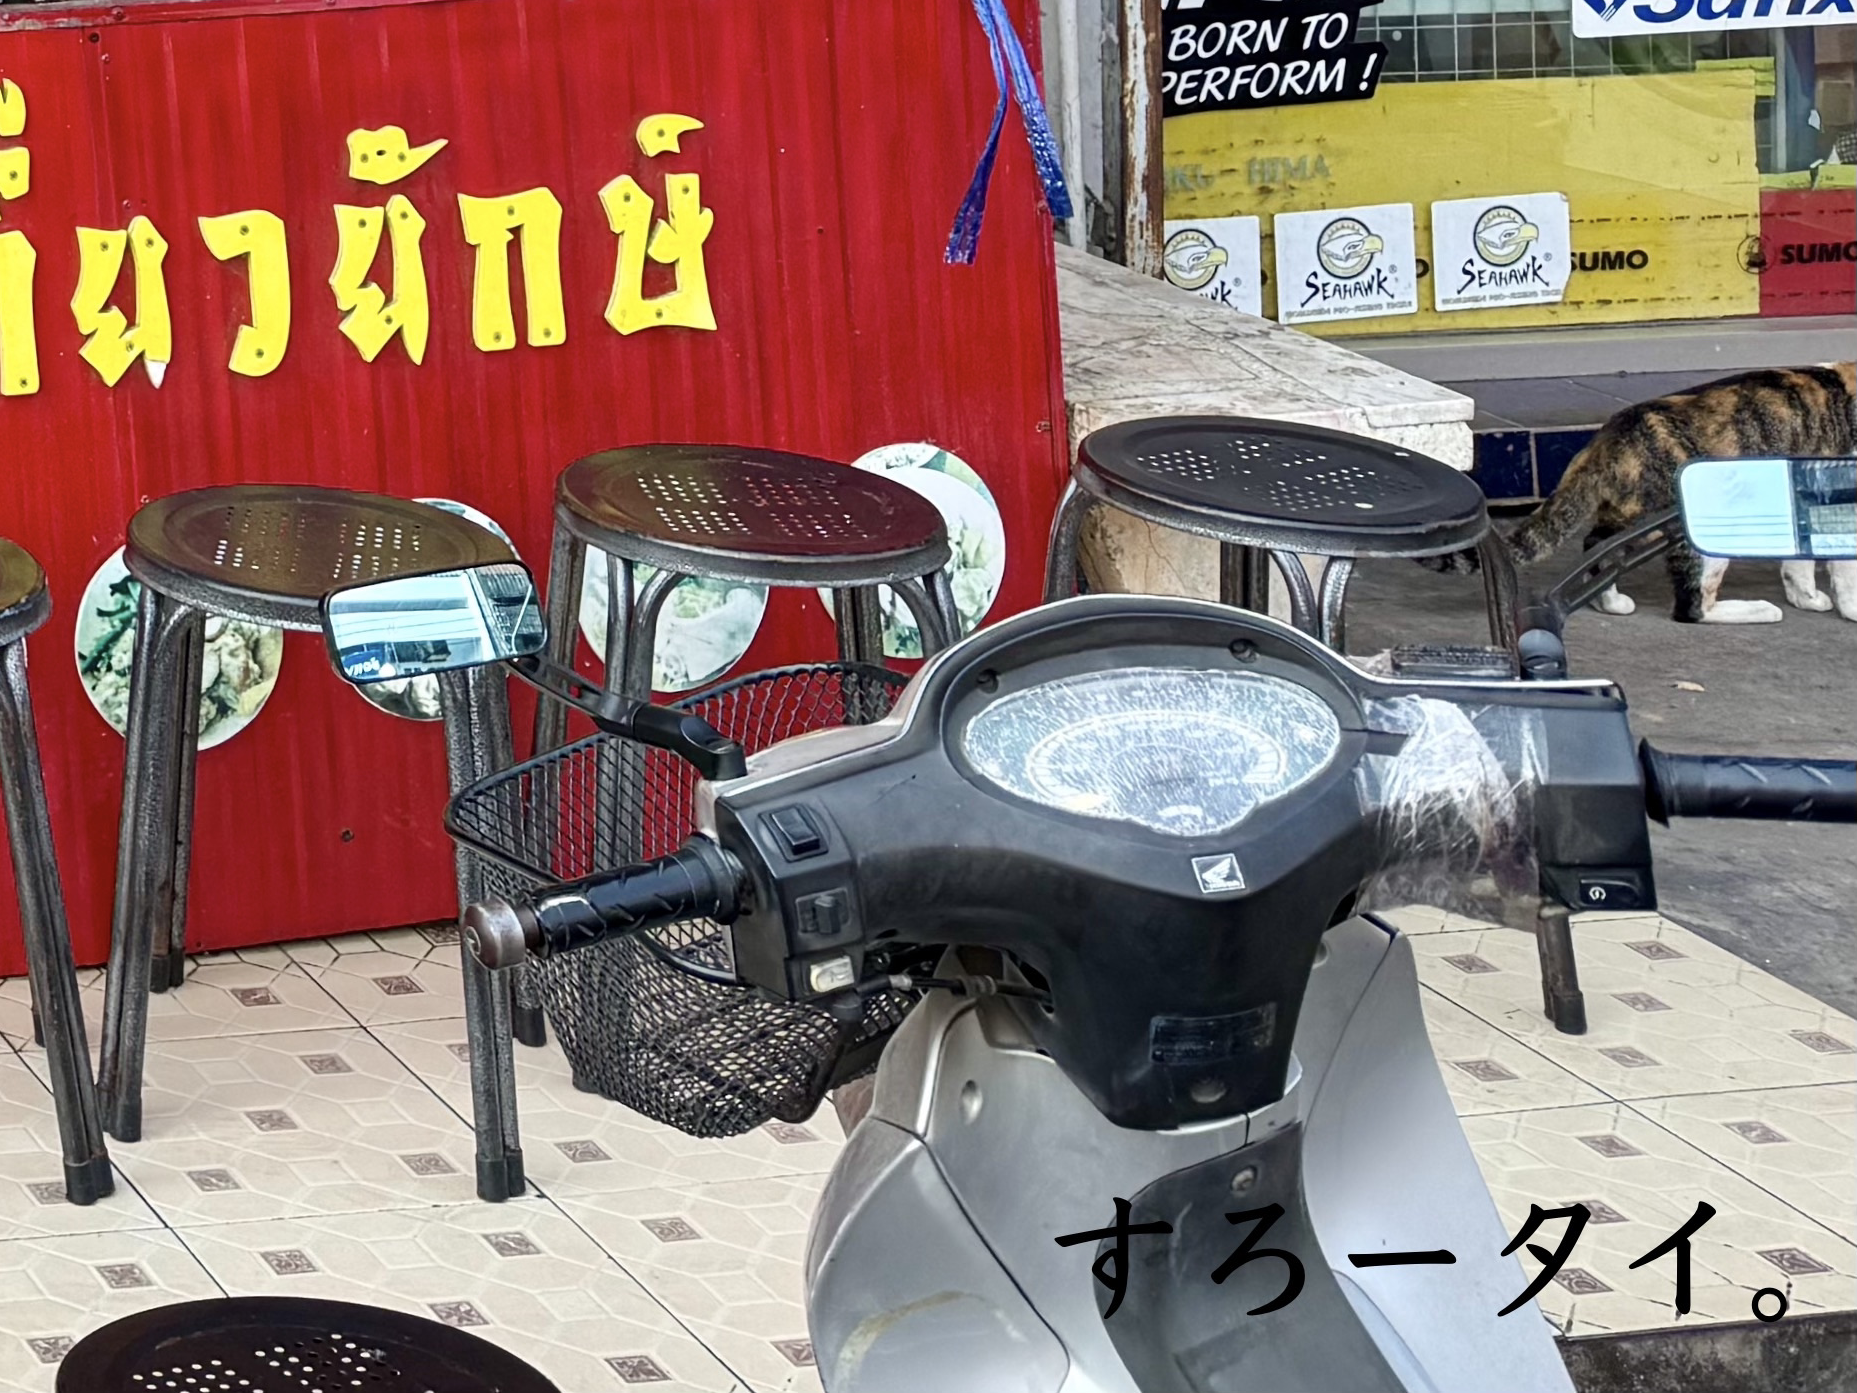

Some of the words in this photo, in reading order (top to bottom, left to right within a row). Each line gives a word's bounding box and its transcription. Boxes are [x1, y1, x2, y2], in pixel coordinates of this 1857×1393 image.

[1167, 19, 1288, 62] BORN
[1300, 11, 1350, 51] TO
[1300, 263, 1396, 308] SEAHAWK
[1456, 251, 1550, 295] SEAHAWK
